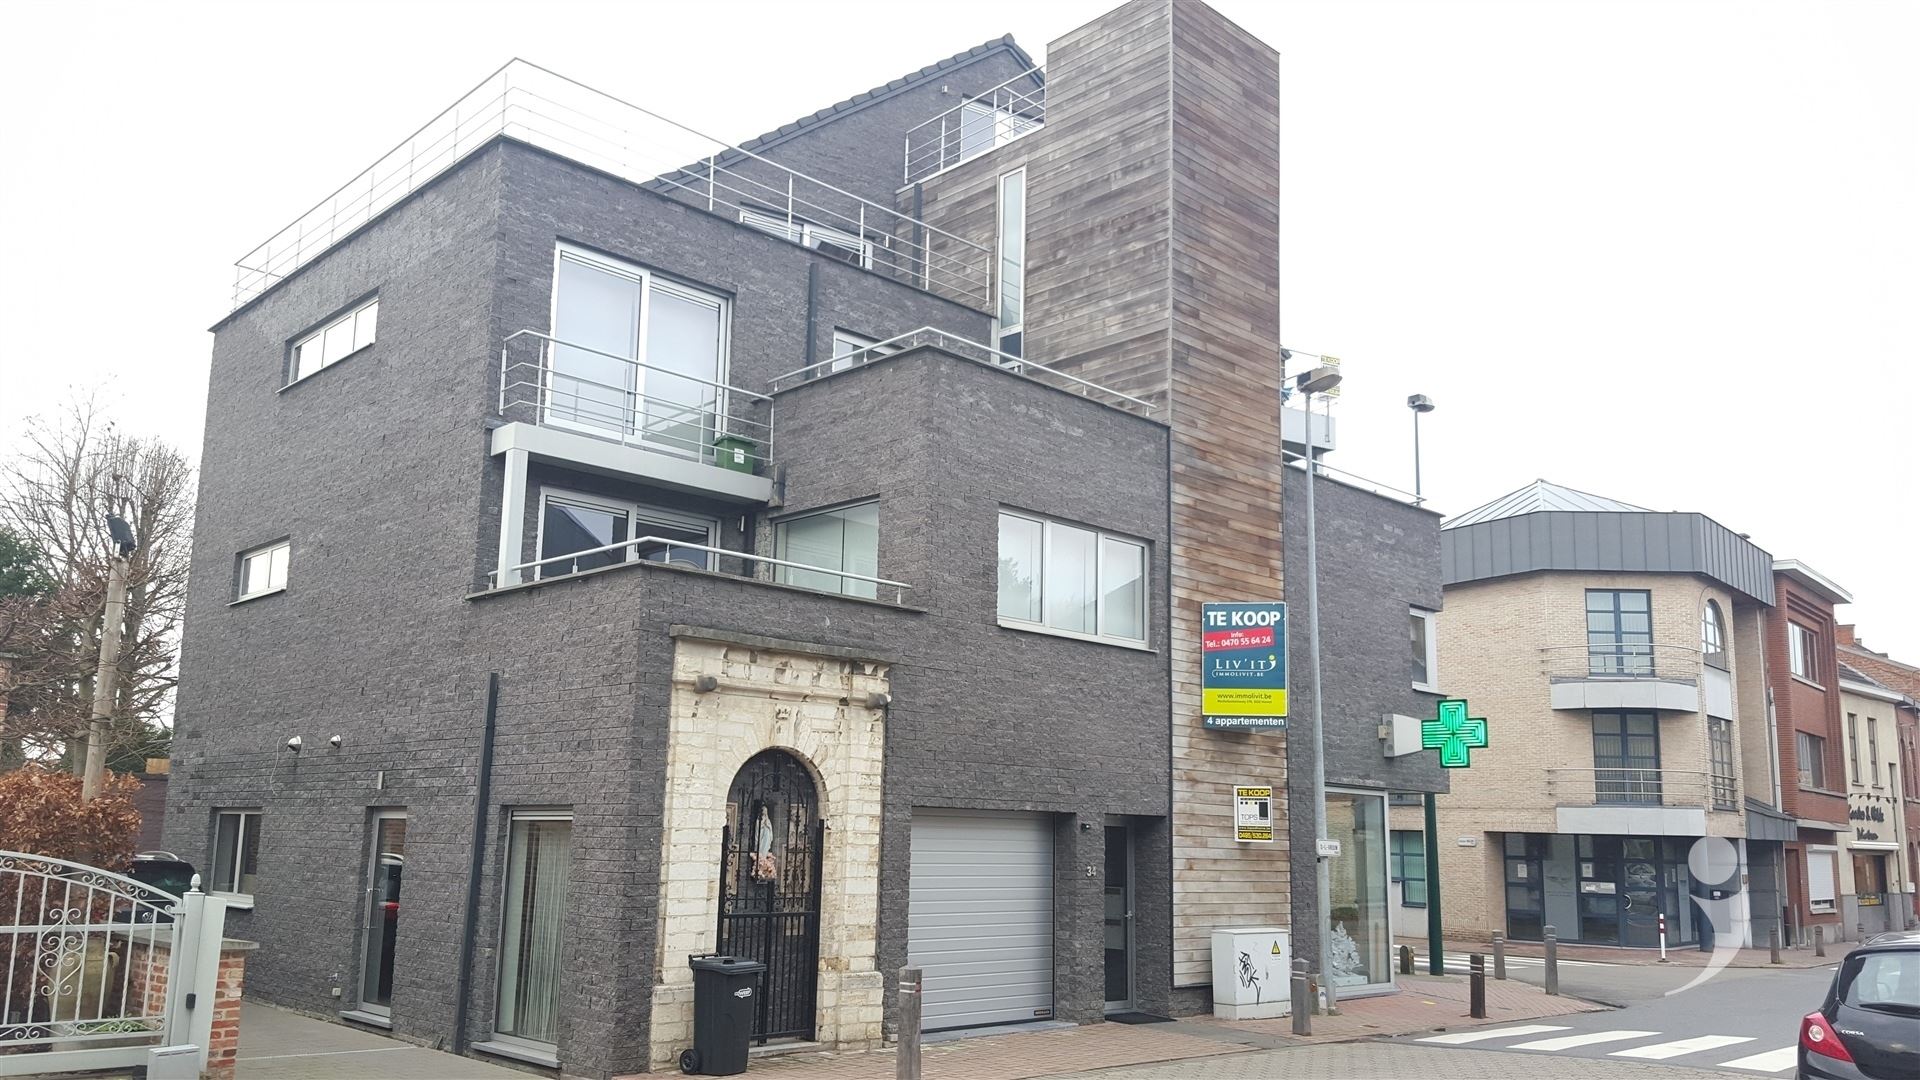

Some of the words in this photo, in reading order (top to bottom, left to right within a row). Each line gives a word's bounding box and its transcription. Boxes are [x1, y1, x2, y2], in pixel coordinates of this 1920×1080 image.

[1207, 611, 1227, 626] TE
[1231, 611, 1281, 626] KOOP
[1221, 638, 1239, 647] 0470
[1240, 637, 1250, 645] 55
[1250, 636, 1260, 644] 64
[1261, 635, 1272, 644] 24
[1217, 692, 1272, 700] www.immolivit.be
[1207, 717, 1213, 725] 4
[1215, 717, 1285, 727] appartementen
